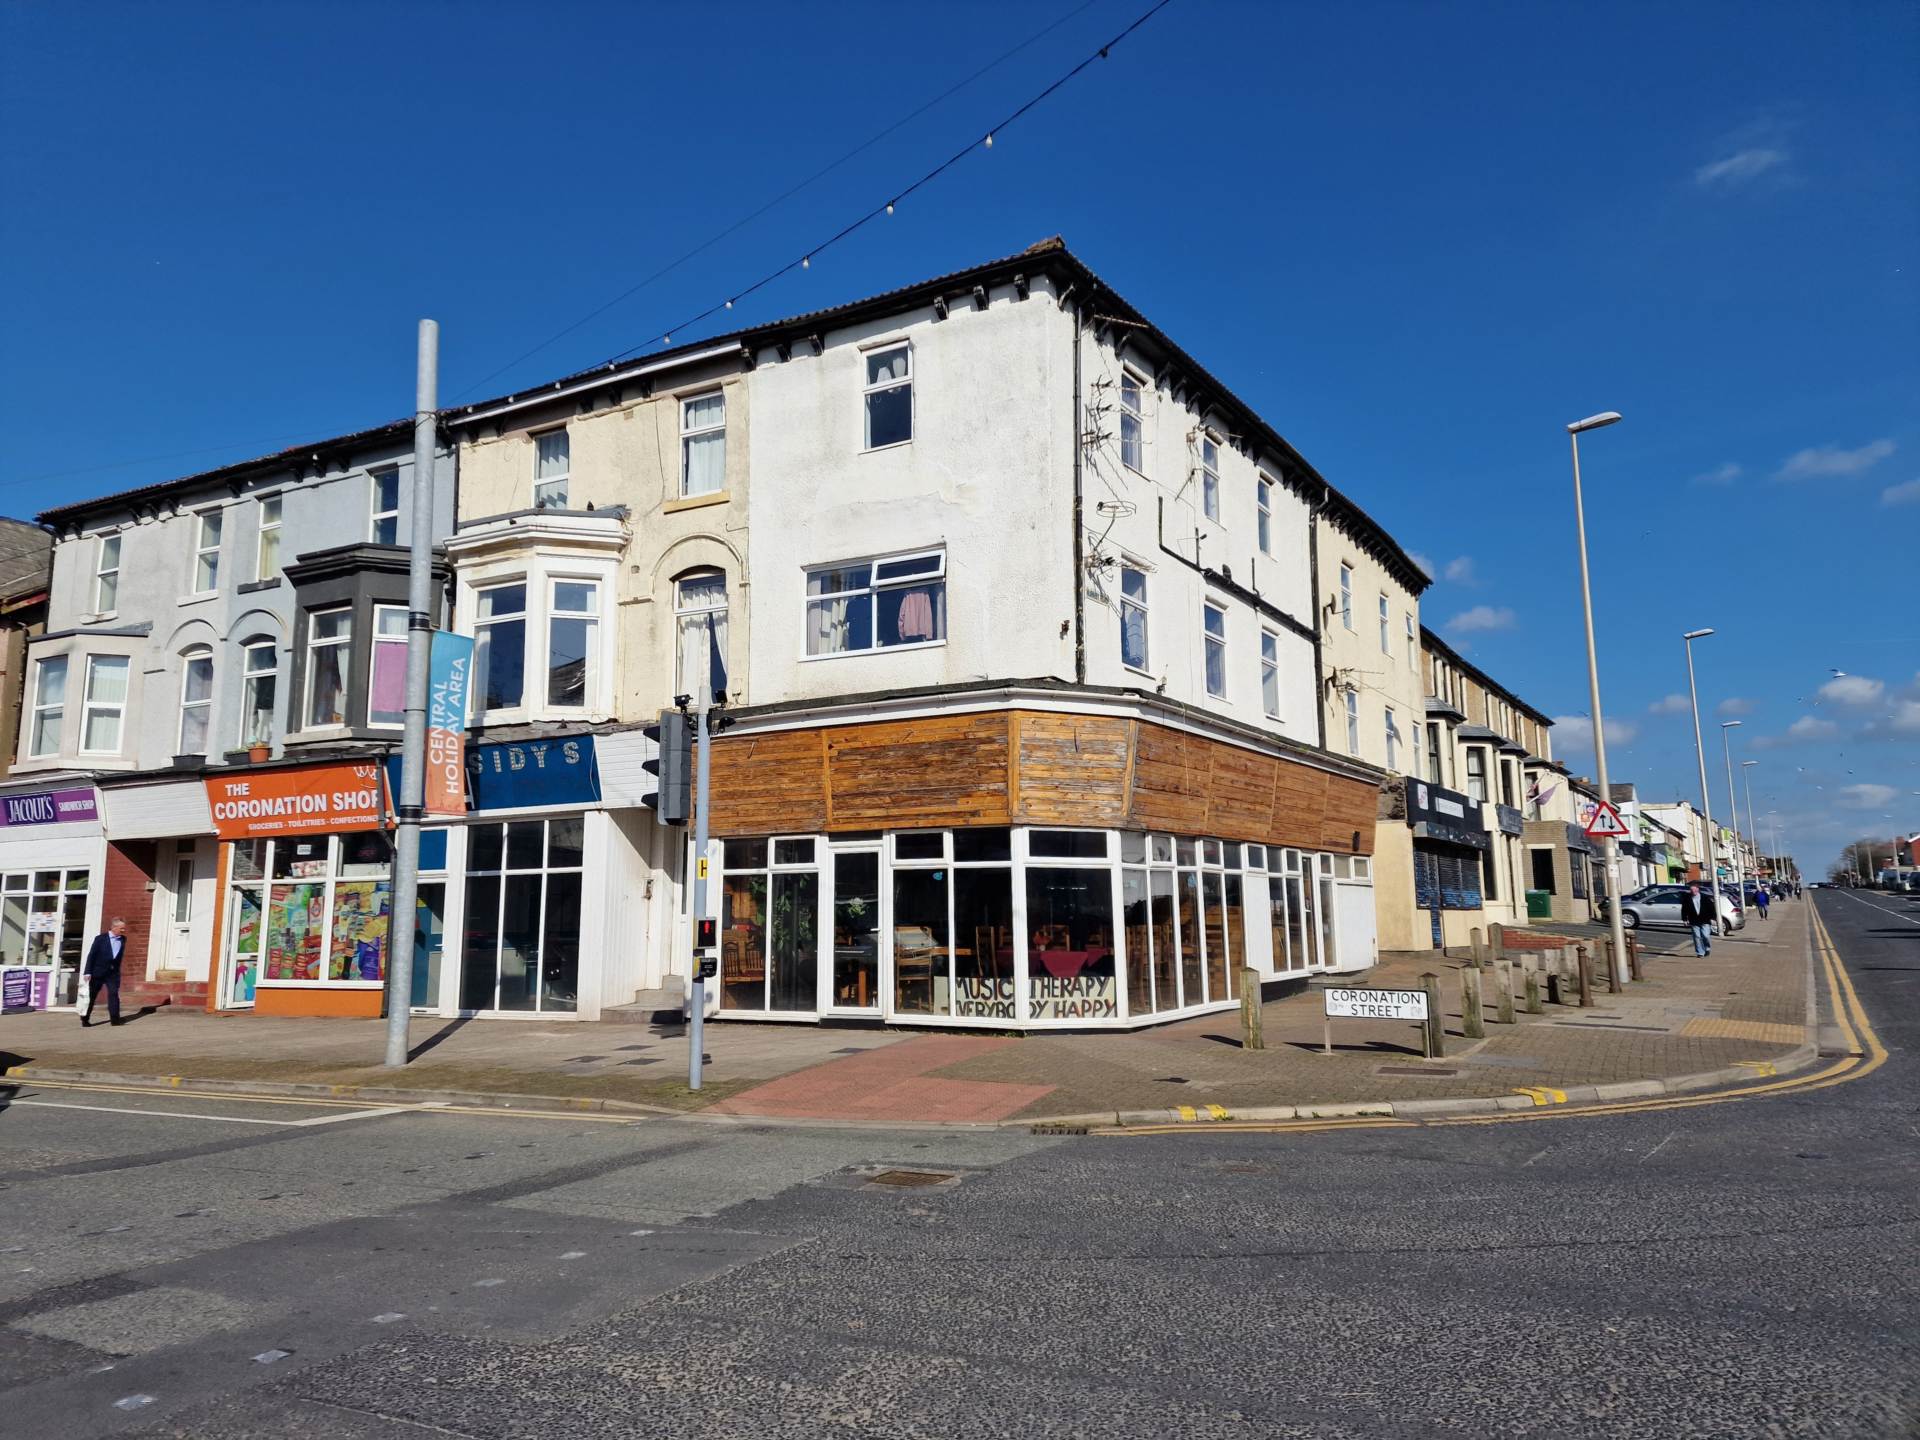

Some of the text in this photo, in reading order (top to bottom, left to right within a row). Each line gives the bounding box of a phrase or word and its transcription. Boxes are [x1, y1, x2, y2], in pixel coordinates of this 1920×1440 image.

[430, 679, 448, 764] CENTRAL
[445, 657, 466, 794] HOLIDAY AREA
[225, 783, 250, 797] THE
[8, 796, 54, 823] JACQUI'S
[214, 794, 327, 820] CORONATION
[1029, 977, 1110, 998] THERAPY
[1331, 990, 1421, 1005] CORONATION
[1054, 999, 1116, 1018] HAPPY
[1351, 1003, 1402, 1017] STREET
